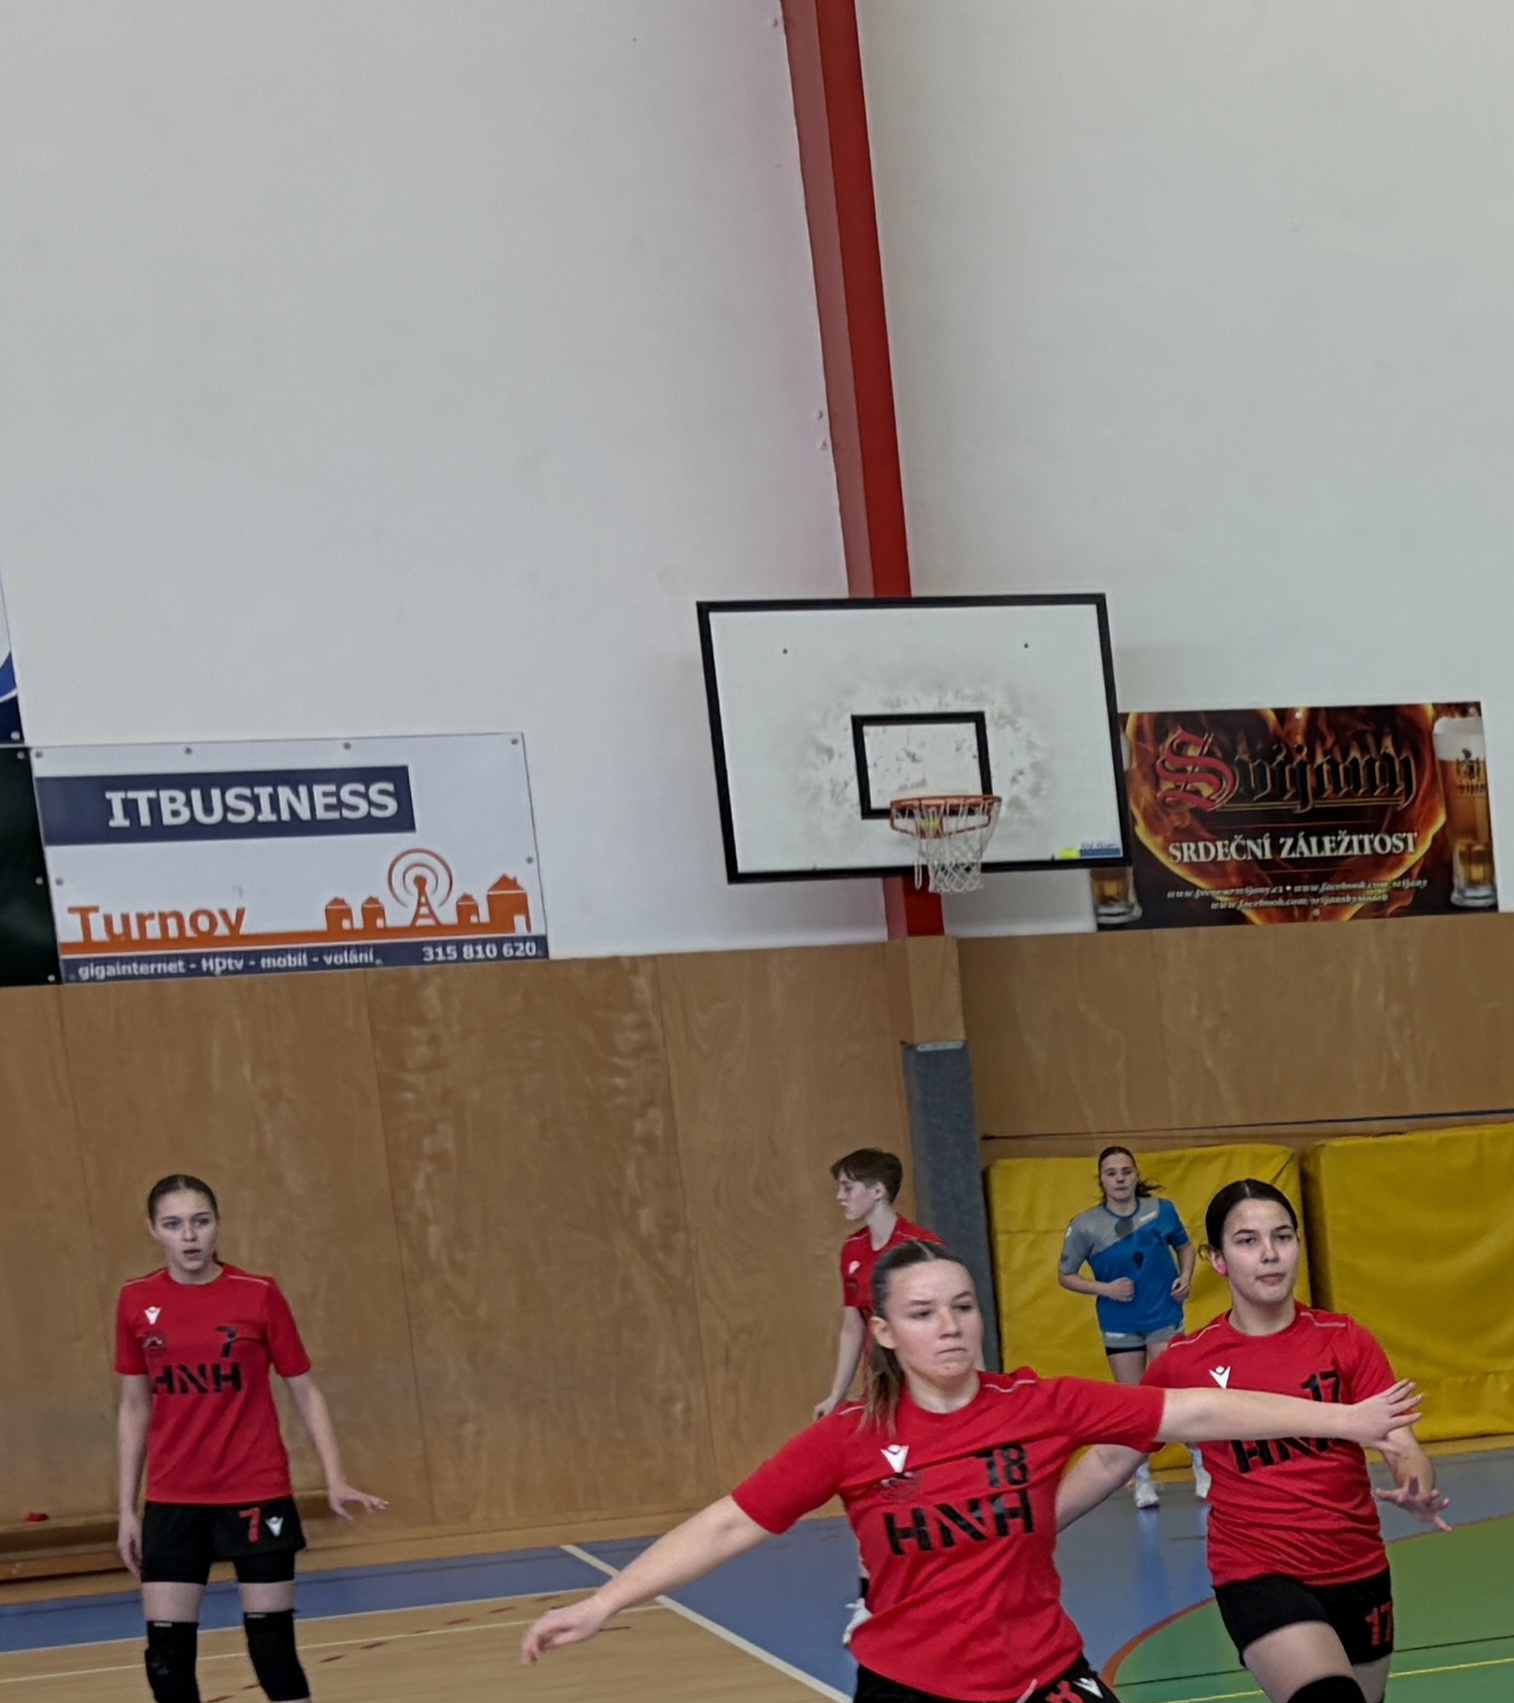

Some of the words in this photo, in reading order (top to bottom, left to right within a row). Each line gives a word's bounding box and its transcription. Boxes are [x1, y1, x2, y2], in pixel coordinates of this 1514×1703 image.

[104, 781, 399, 829] ITBUSINESS
[1168, 833, 1274, 864] SRDEČNÍ
[1279, 829, 1418, 860] ZÁLEŽITOST
[66, 906, 247, 944] Turnov
[78, 957, 186, 982] gigainternet
[260, 952, 308, 969] mobil
[421, 945, 459, 962] 315
[462, 943, 498, 960] 810
[502, 941, 537, 957] 620
[216, 1325, 237, 1358] 7
[153, 1361, 242, 1395] HNH
[973, 1442, 1031, 1488] 18
[239, 1507, 260, 1543] 7
[882, 1489, 1035, 1557] HNH
